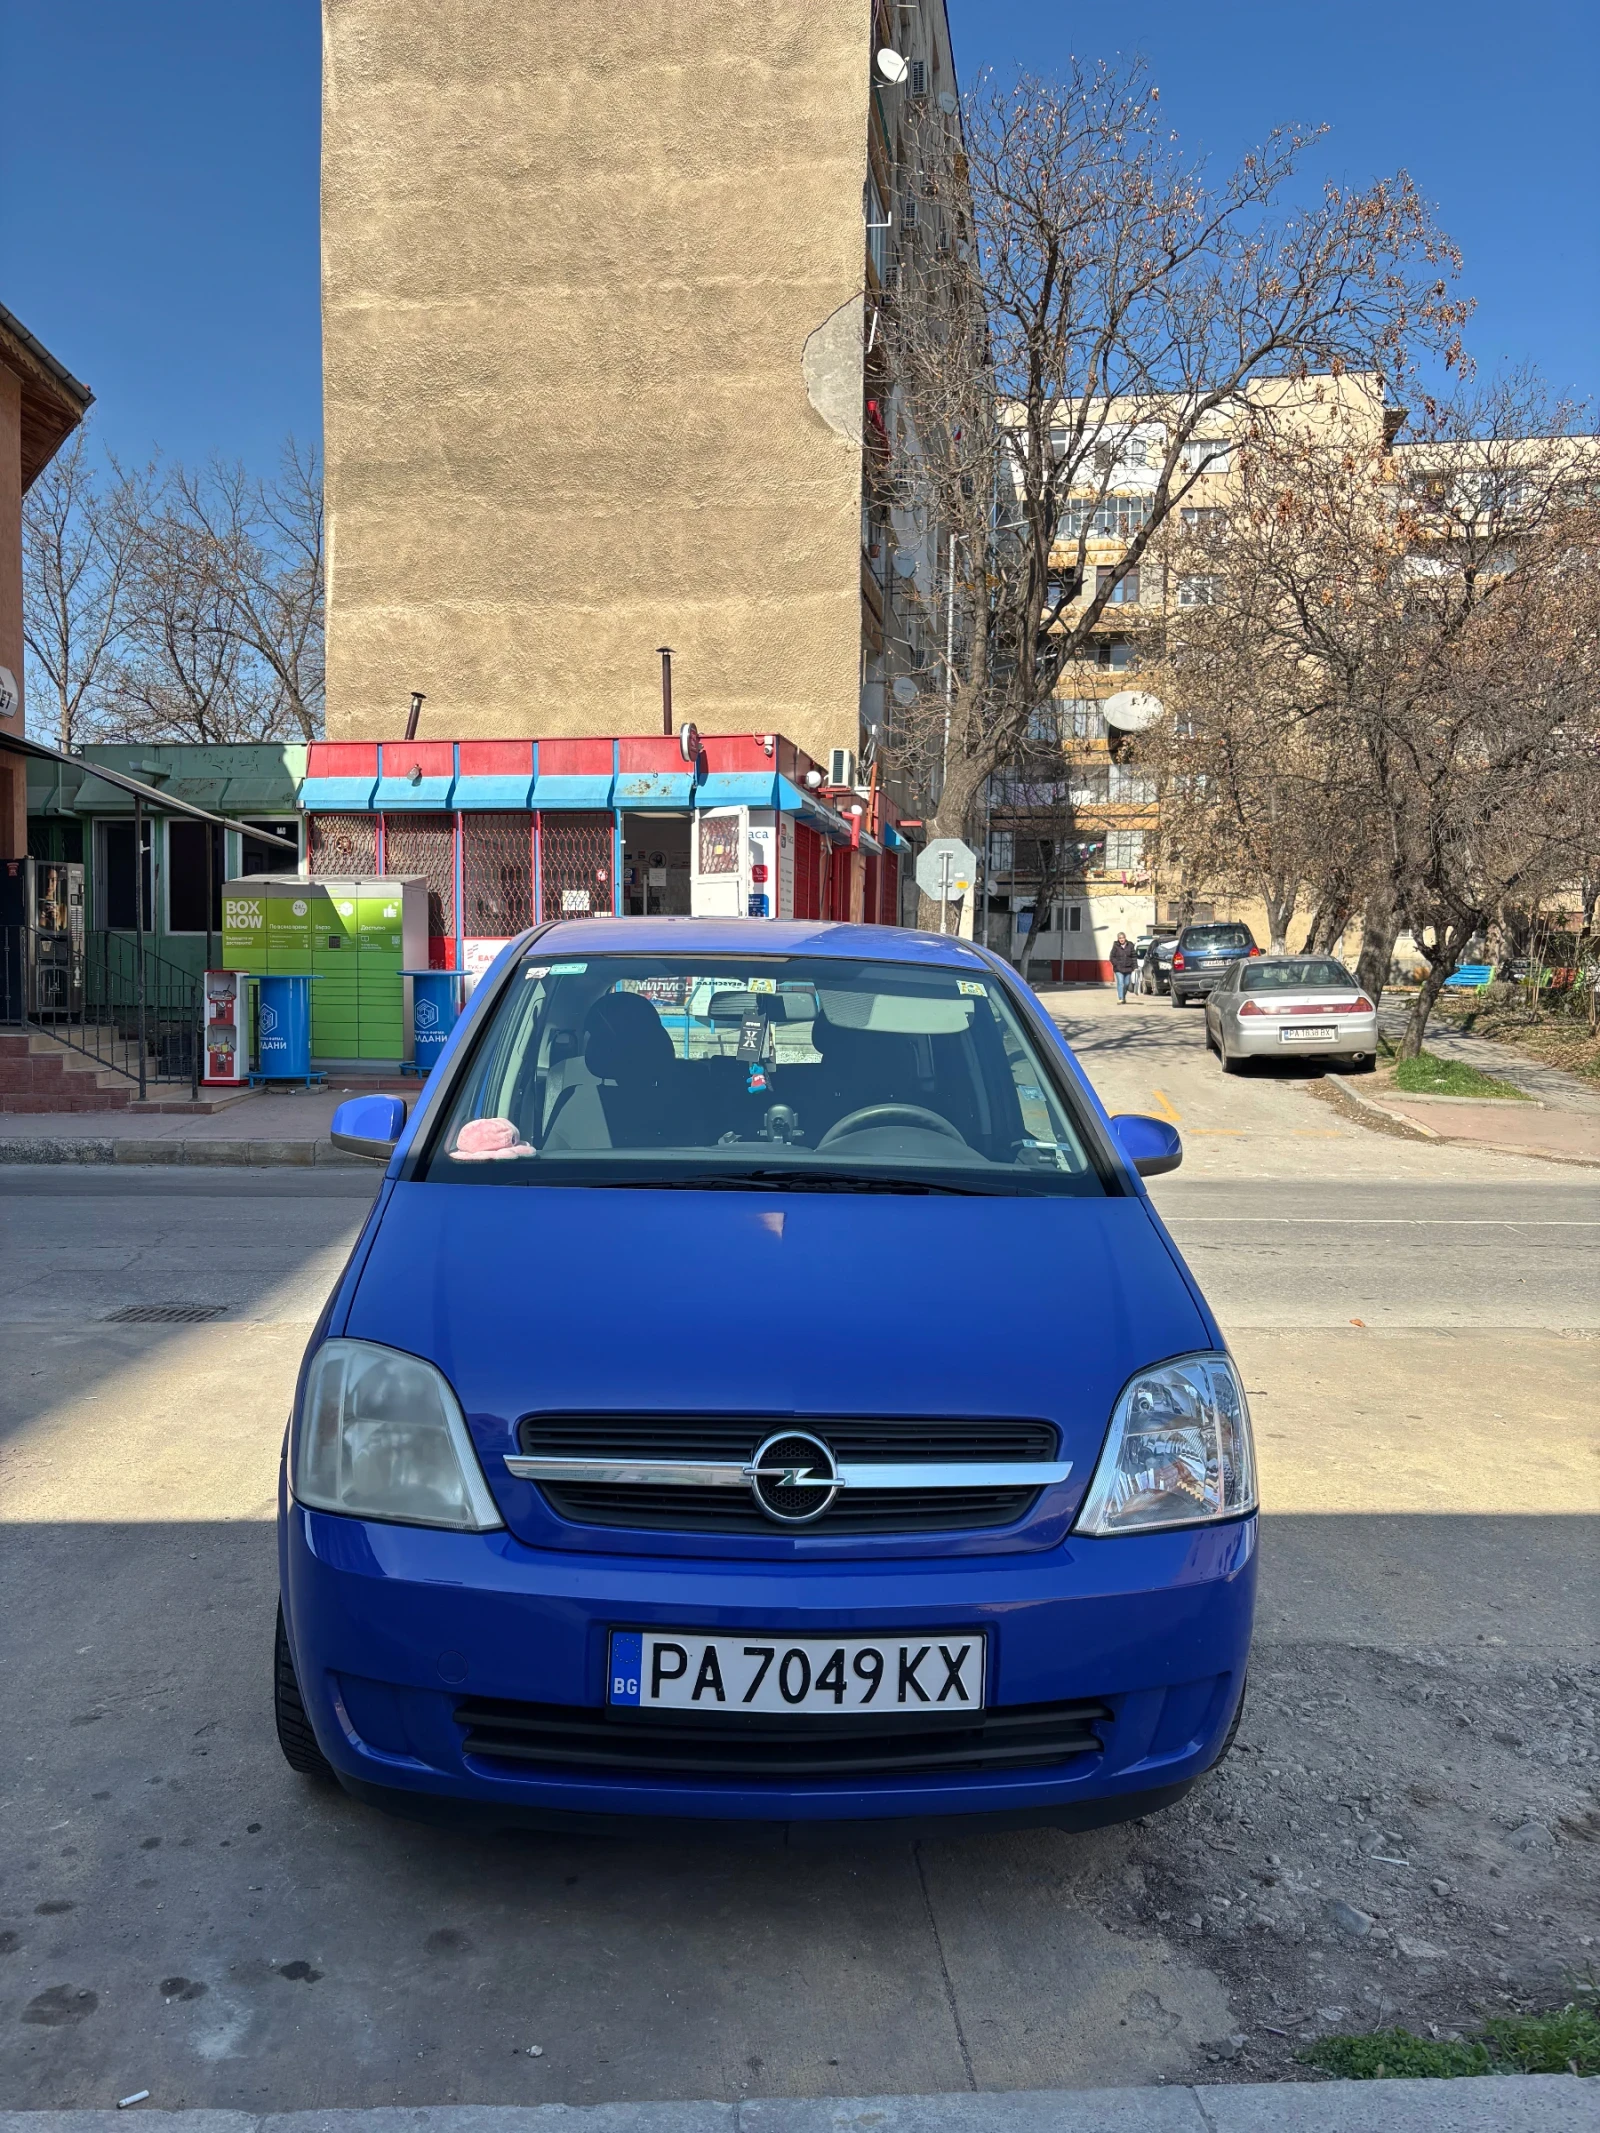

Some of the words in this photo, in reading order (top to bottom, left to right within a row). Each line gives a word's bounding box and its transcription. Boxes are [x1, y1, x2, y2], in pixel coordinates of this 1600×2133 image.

[226, 900, 260, 915] BOX
[226, 915, 263, 929] NOW
[613, 1677, 638, 1695] BG
